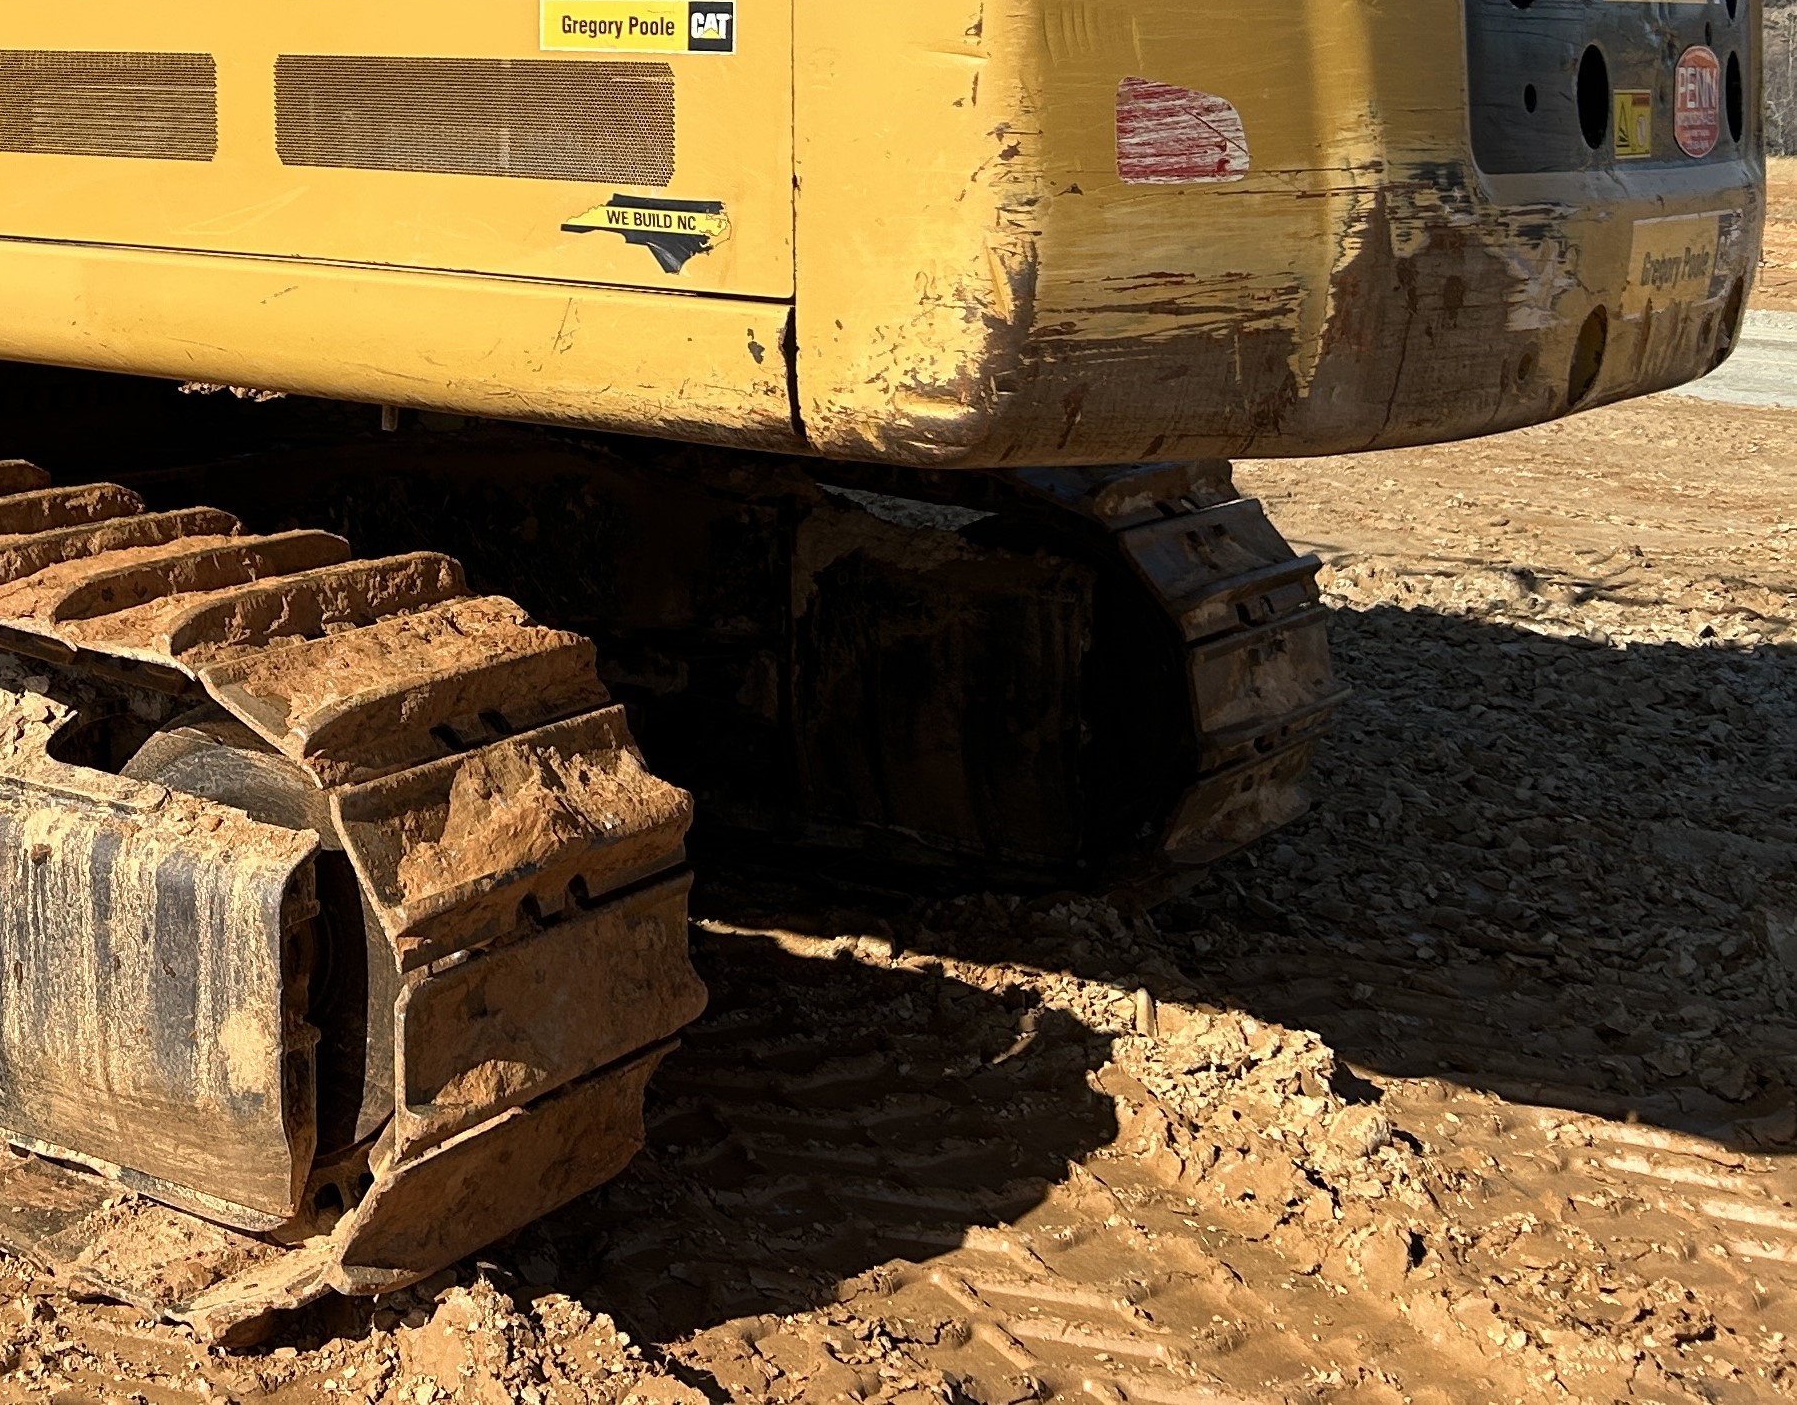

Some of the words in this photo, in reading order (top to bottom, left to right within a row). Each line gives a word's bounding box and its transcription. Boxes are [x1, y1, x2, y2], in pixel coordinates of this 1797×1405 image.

[562, 15, 623, 38] Gregory
[628, 16, 675, 36] Poole
[690, 12, 732, 40] CAT
[1677, 66, 1718, 109] PENN
[605, 209, 630, 226] WE
[633, 213, 673, 229] BUILD
[677, 216, 697, 231] NC
